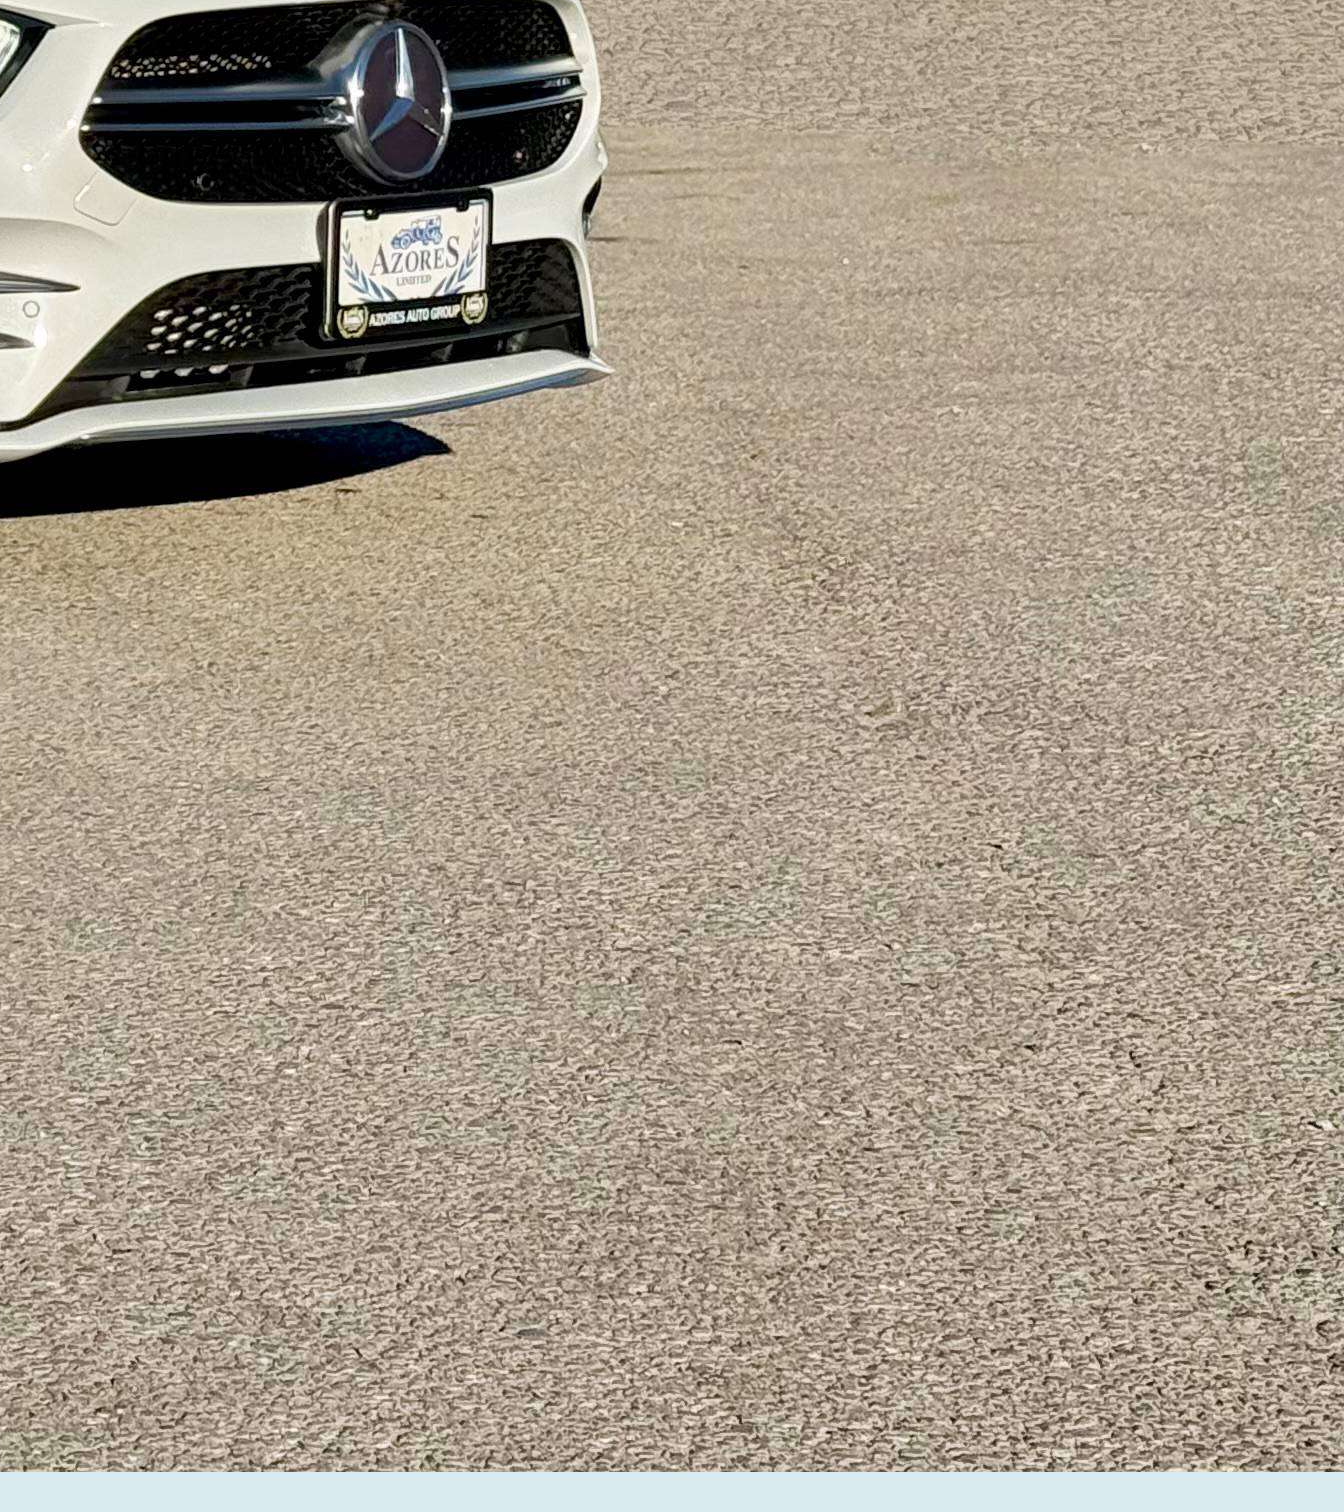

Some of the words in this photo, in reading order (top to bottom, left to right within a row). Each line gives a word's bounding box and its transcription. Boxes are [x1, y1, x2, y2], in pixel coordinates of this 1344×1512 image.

[370, 236, 460, 276] AZORES
[396, 274, 432, 287] LIMITED
[368, 310, 406, 327] AZORES
[406, 308, 429, 323] AUTO
[430, 304, 462, 321] GROUP
